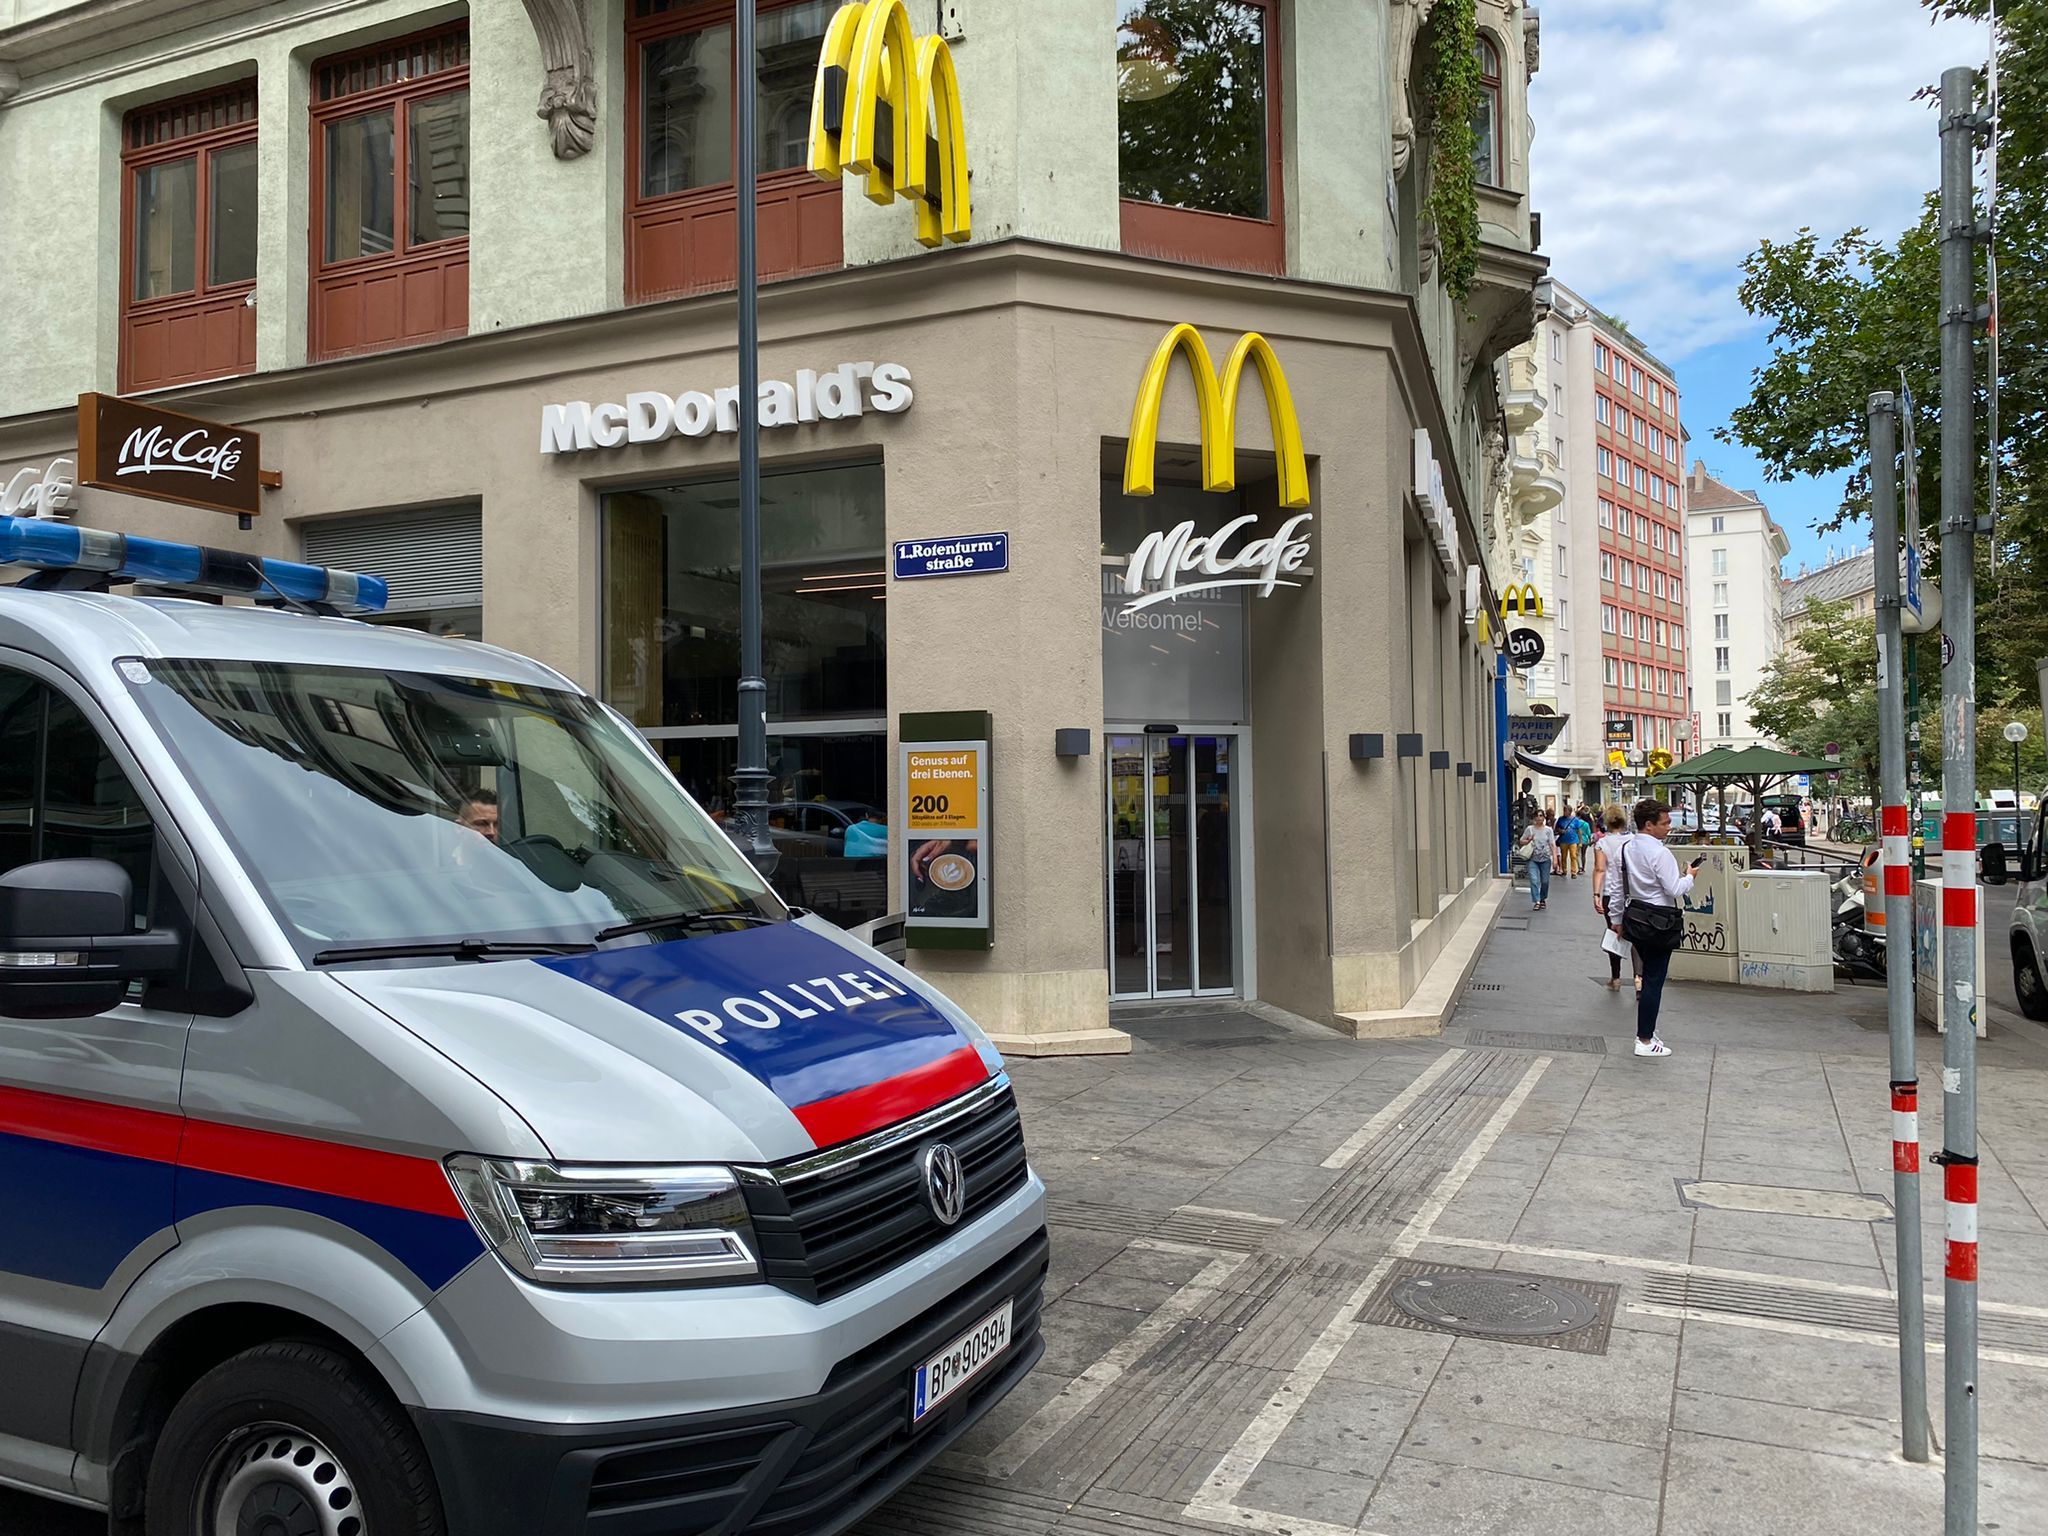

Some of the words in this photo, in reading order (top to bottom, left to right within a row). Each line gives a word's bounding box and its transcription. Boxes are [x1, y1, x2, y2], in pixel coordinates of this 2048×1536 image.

[540, 360, 914, 454] McDonald's
[117, 425, 242, 480] McCafé
[925, 554, 975, 571] straße
[1122, 512, 1314, 603] McCafé
[1508, 634, 1538, 655] bin
[1511, 721, 1554, 730] PAPIER
[1510, 732, 1553, 741] HAFEN
[911, 756, 949, 767] Genuss
[950, 754, 968, 765] auf
[911, 768, 931, 779] drei
[932, 768, 973, 779] Ebenen.
[911, 794, 949, 813] 200
[673, 969, 908, 1045] POLIZEI
